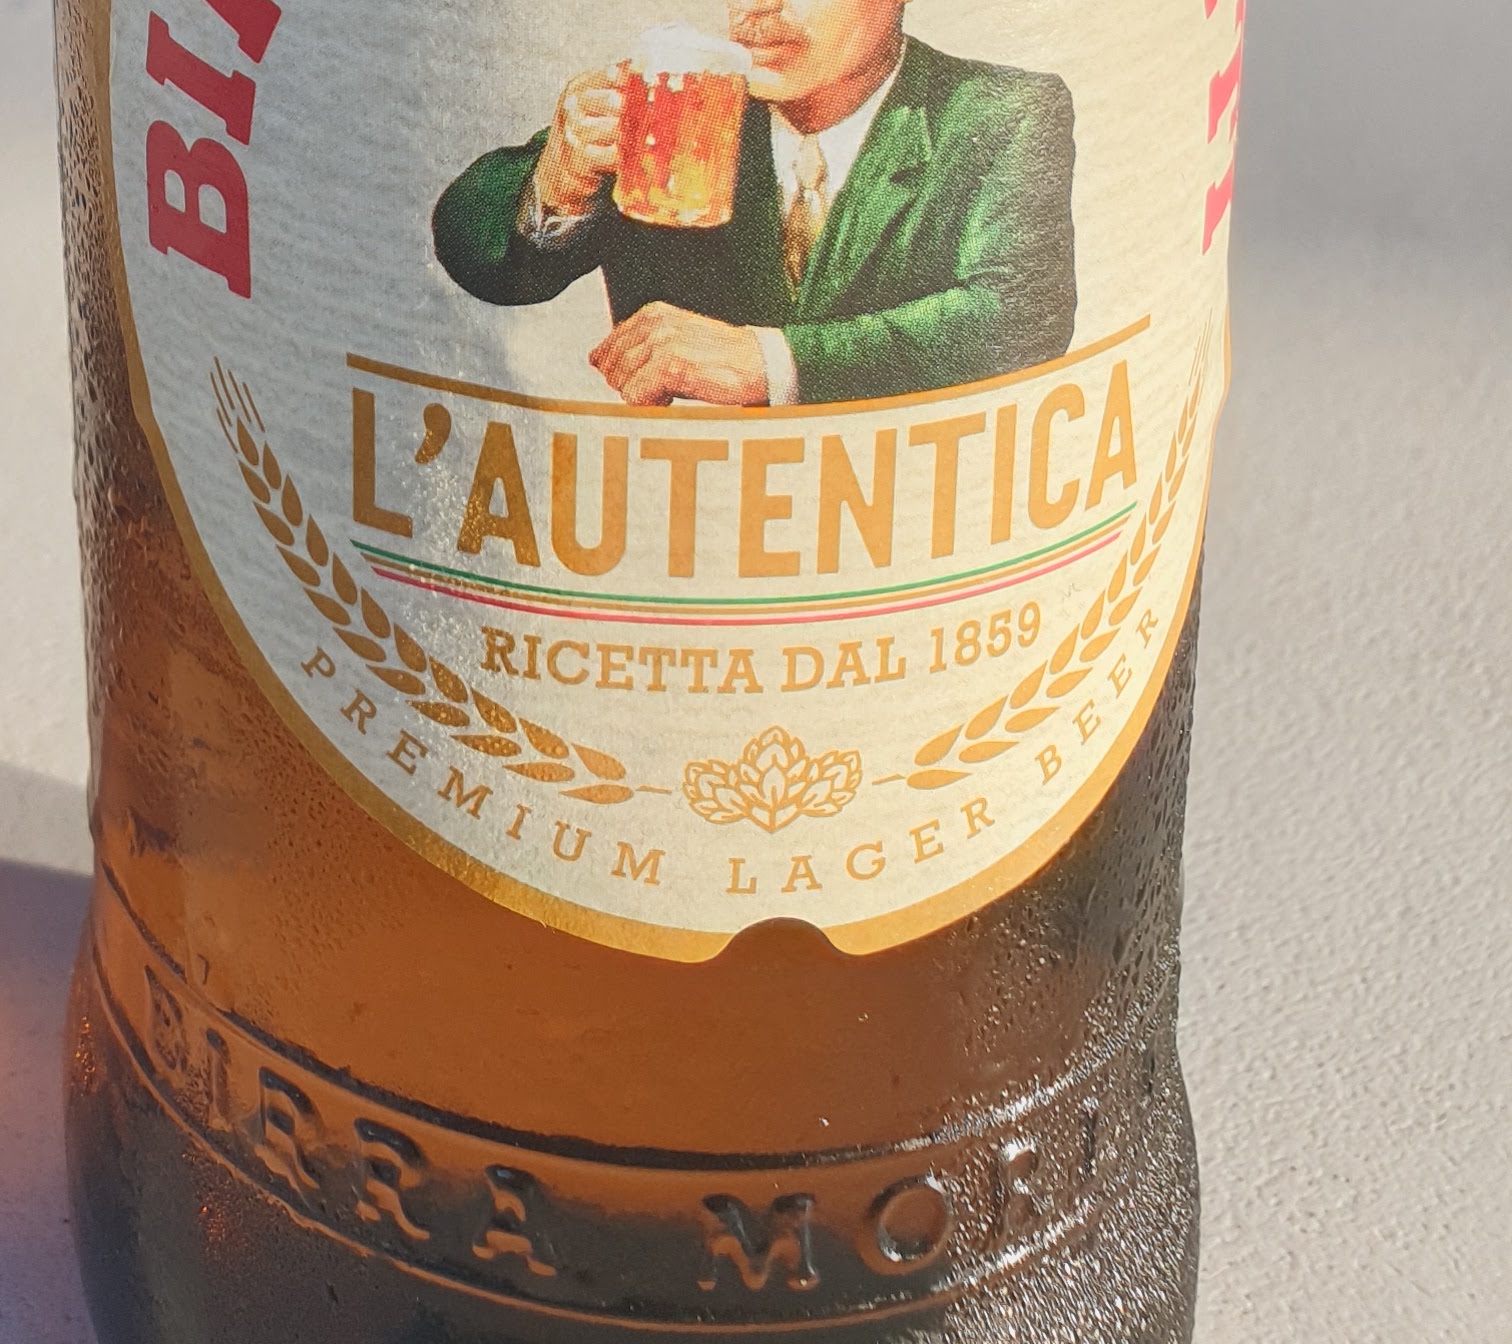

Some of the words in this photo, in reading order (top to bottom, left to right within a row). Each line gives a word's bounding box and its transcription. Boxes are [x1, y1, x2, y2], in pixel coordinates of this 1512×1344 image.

[350, 358, 1140, 580] L'AUTENTICA
[300, 647, 667, 886] PREMIUM
[726, 797, 996, 894] LAGER
[1034, 608, 1159, 786] BEER
[479, 625, 764, 694] RICETTA
[781, 636, 907, 693] DAL
[929, 601, 1041, 673] 1859
